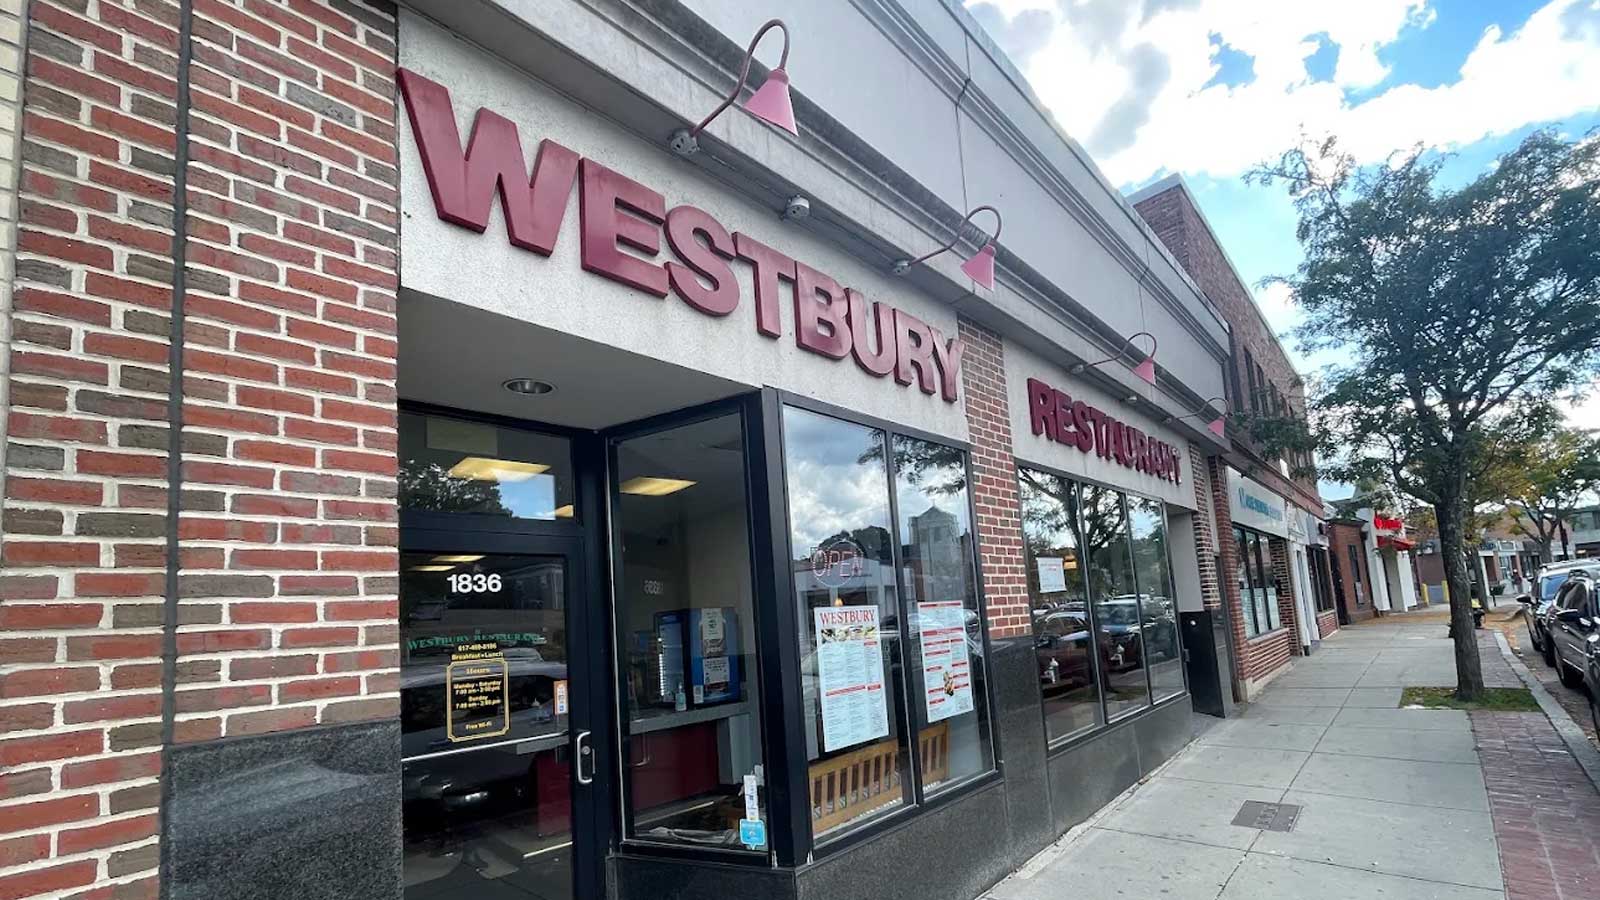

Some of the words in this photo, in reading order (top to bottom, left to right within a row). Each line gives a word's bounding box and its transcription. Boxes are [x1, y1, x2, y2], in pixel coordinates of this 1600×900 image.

[398, 68, 964, 403] WESTBURY
[1027, 377, 1182, 487] RESTAURANT
[812, 549, 864, 578] OPEN
[447, 573, 502, 594] 1836
[819, 609, 876, 626] WESTBURY
[407, 635, 469, 650] WESTBURY
[451, 652, 481, 661] Breakfast
[484, 651, 504, 659] Lunch
[466, 667, 490, 675] Hours
